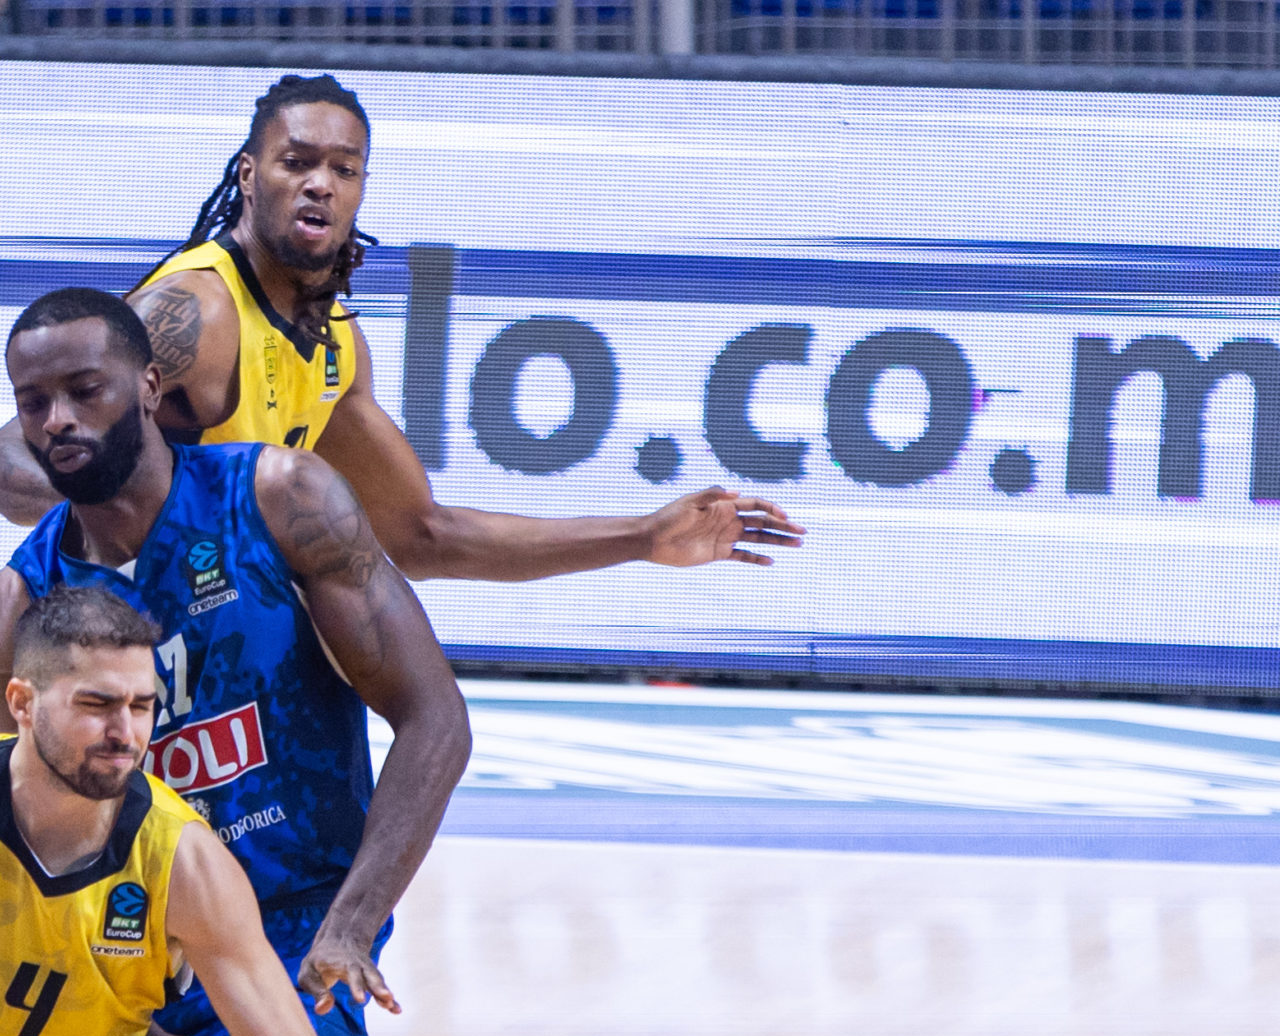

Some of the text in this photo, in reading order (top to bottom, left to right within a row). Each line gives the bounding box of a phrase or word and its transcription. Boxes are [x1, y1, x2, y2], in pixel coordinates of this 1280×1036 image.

[194, 579, 226, 596] EuroCup
[187, 588, 239, 616] oneteam
[213, 804, 287, 846] ODGORICA
[111, 916, 140, 929] BKT
[106, 928, 143, 940] EuroCup
[91, 945, 145, 957] oneteam
